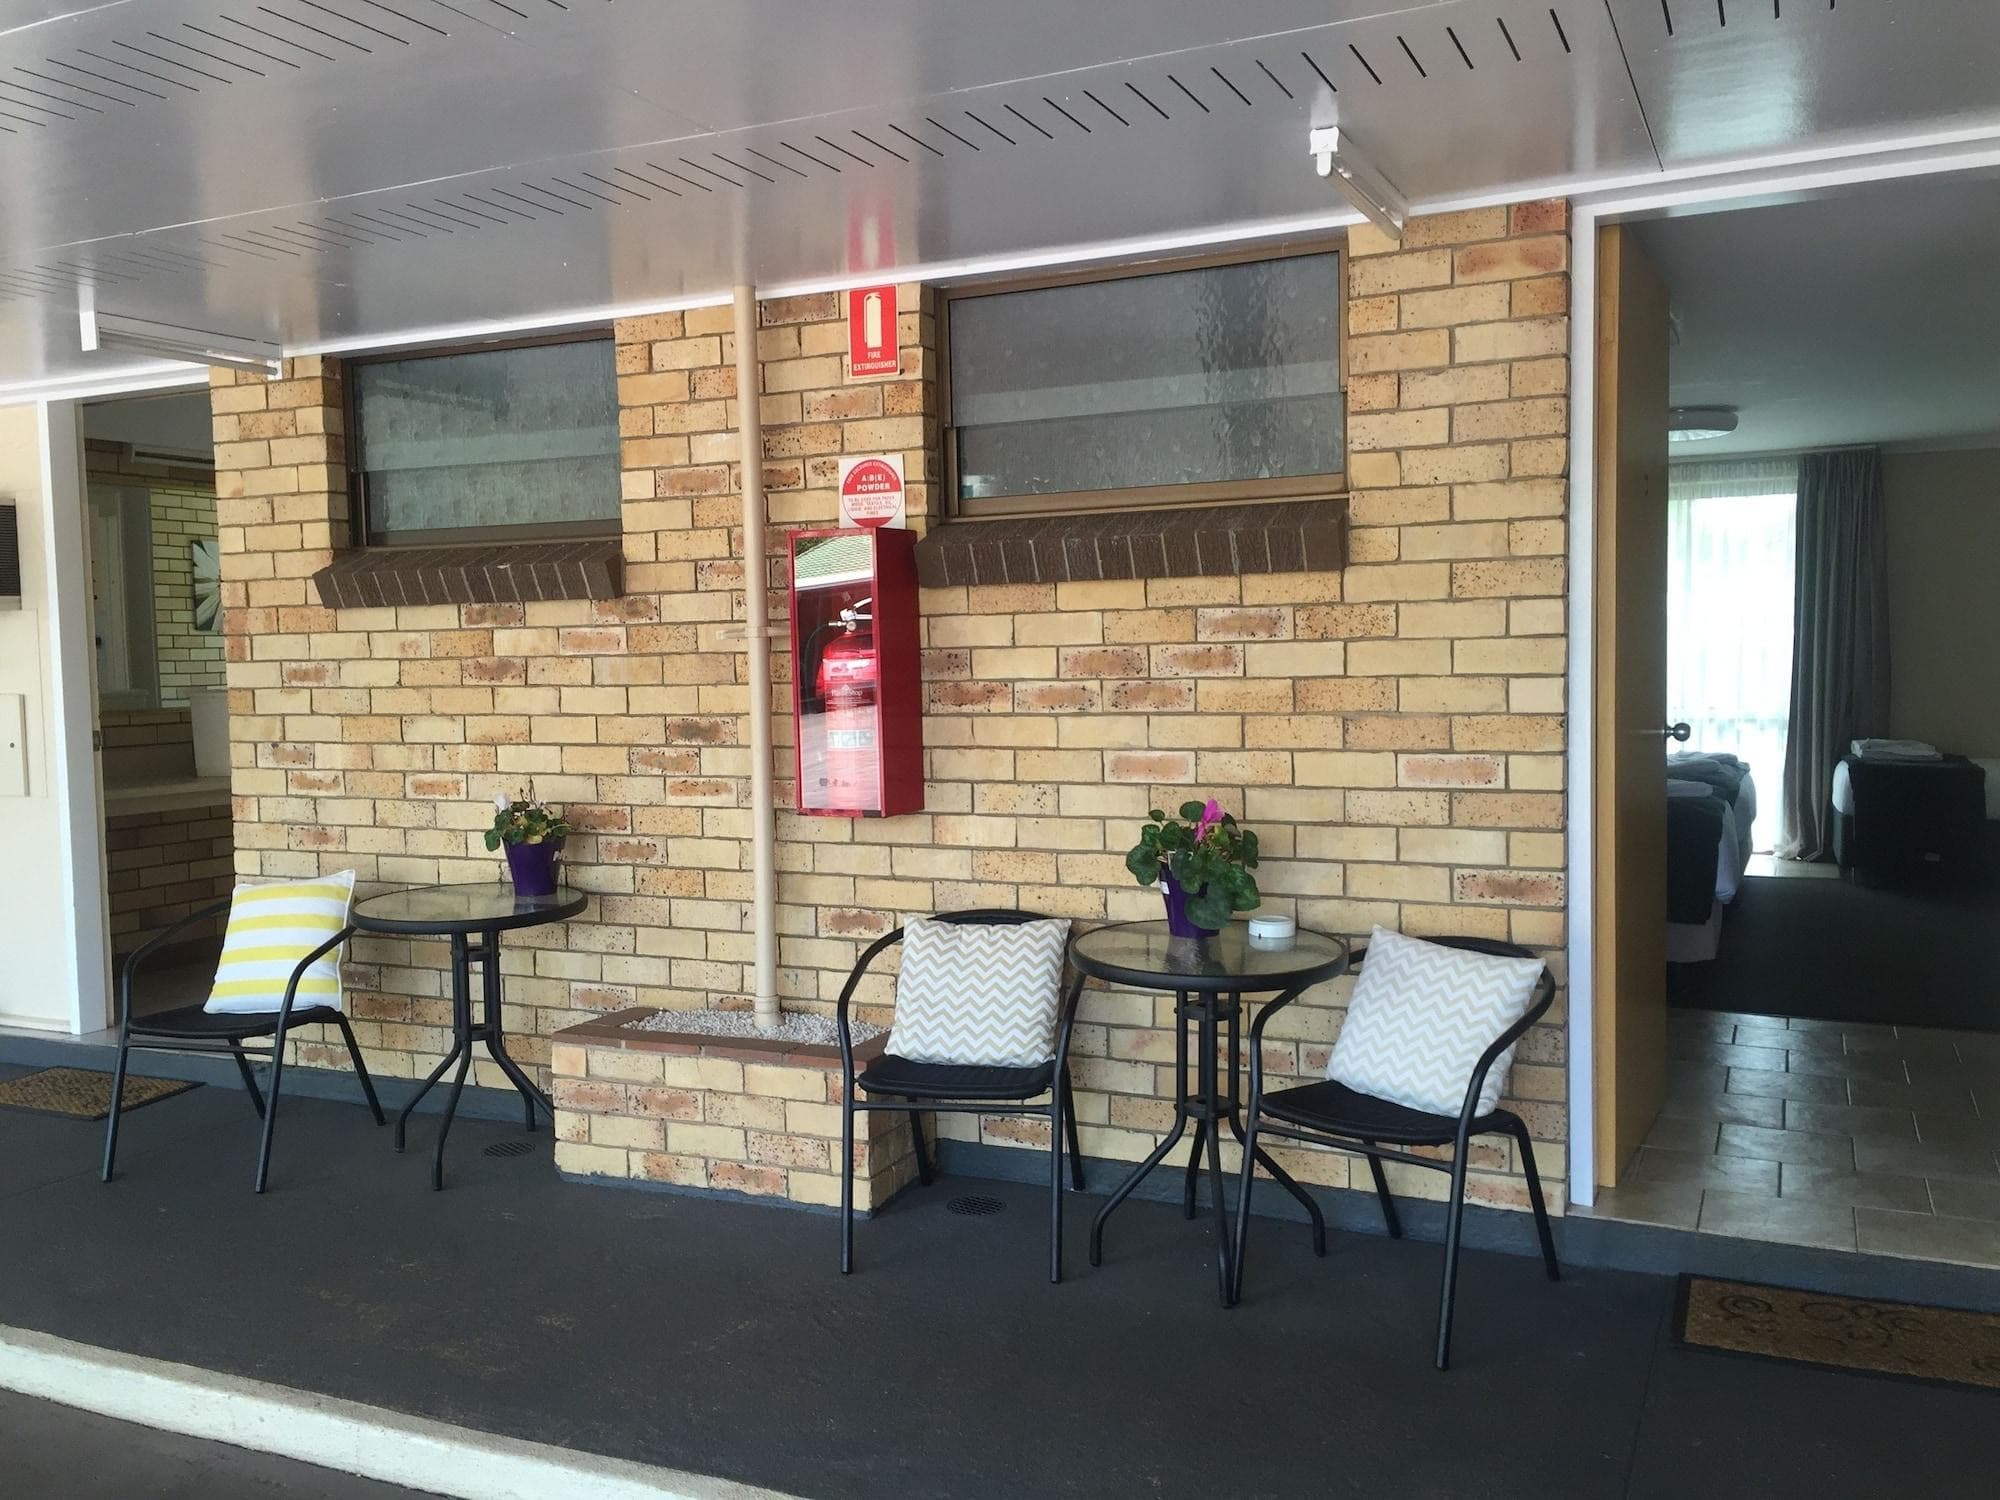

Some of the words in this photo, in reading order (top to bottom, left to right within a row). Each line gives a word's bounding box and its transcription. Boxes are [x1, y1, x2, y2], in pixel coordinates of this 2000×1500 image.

[867, 351, 881, 359] FIRE
[853, 360, 896, 371] EXTINGUISHER
[856, 483, 890, 492] POWDER
